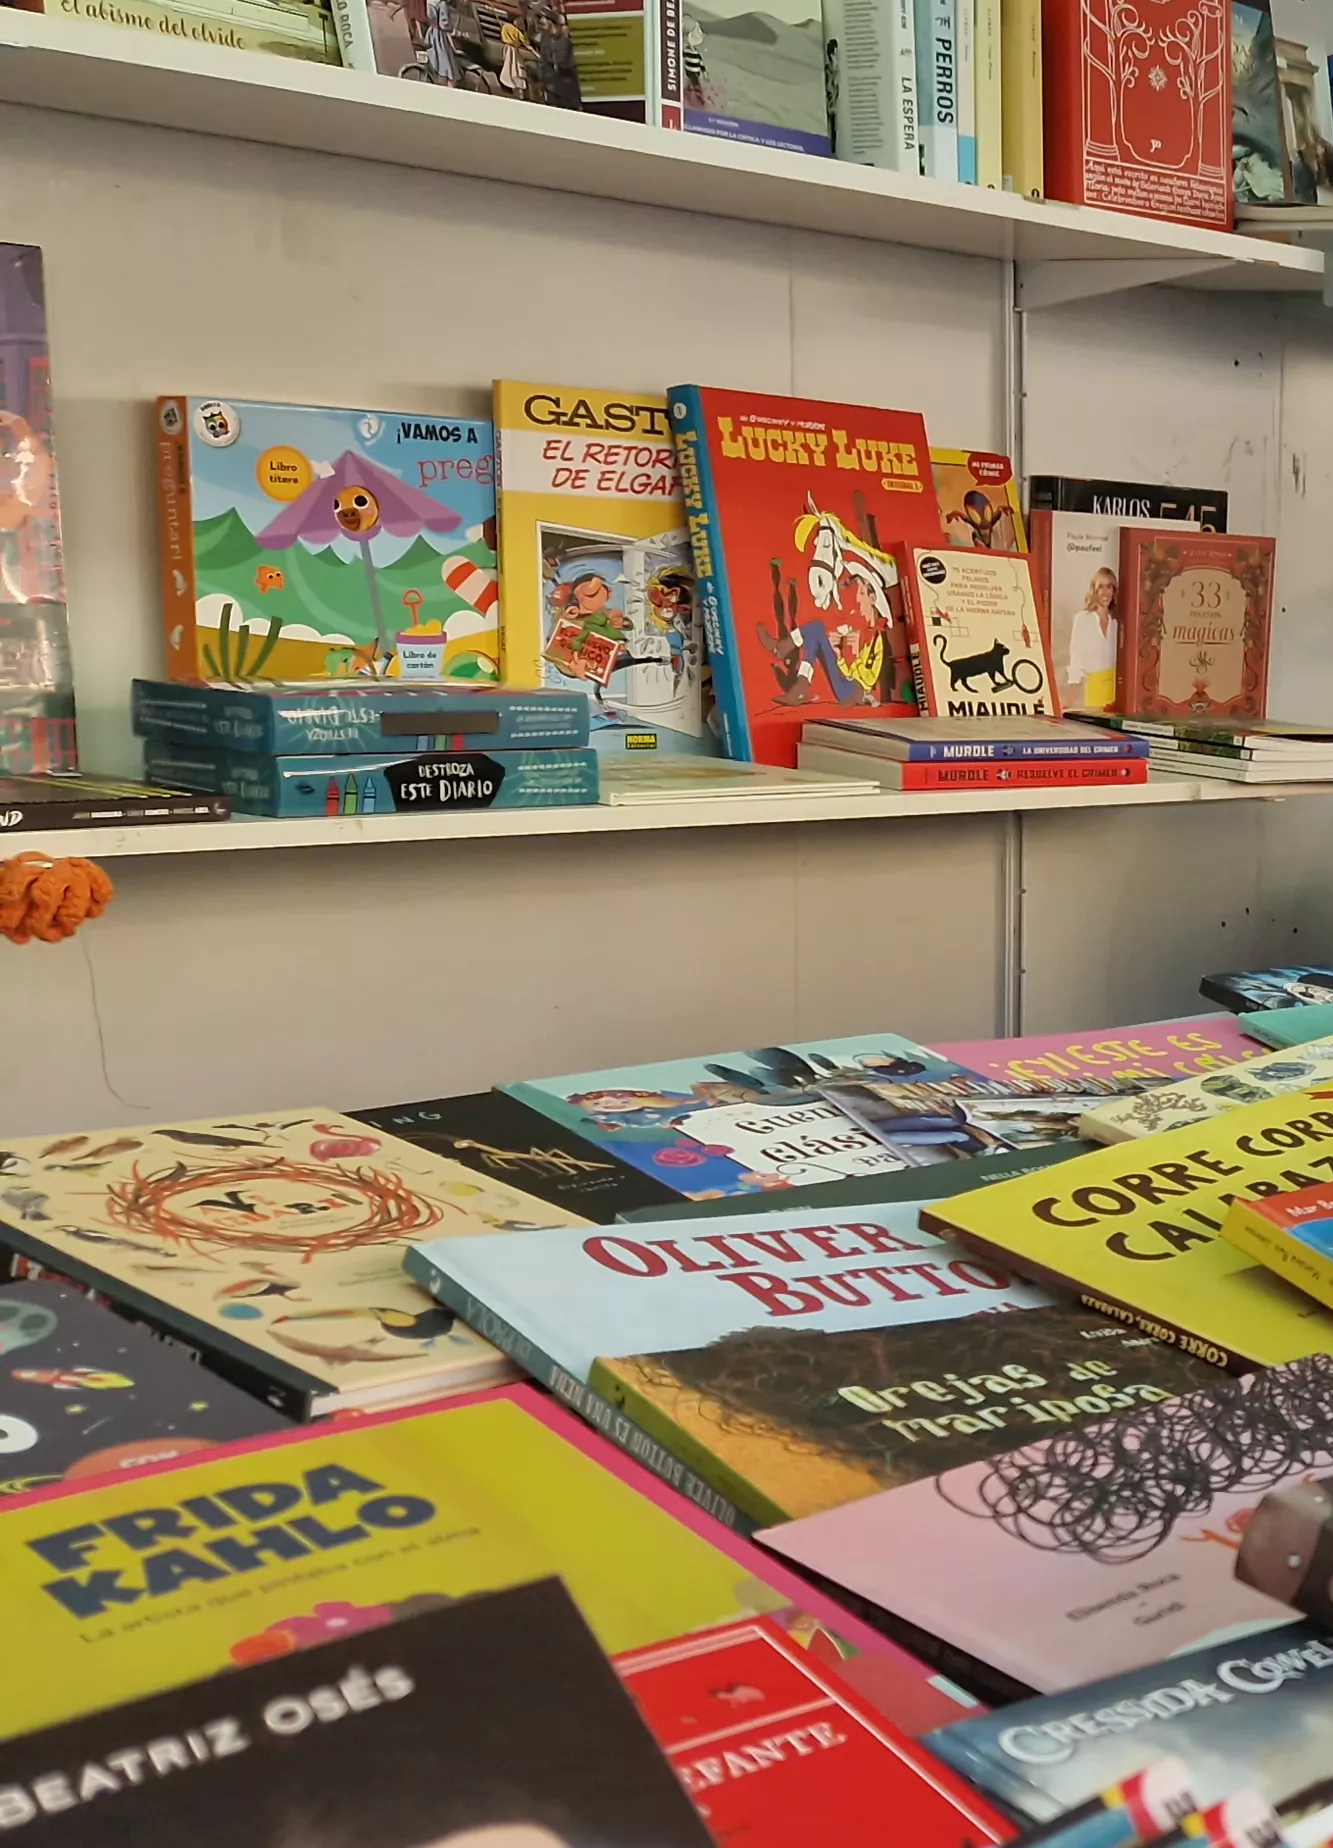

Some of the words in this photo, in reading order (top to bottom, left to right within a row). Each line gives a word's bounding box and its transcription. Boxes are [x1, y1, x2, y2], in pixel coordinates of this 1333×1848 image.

[86, 2, 153, 30] abismo
[159, 18, 188, 38] del
[191, 22, 245, 50] olvido
[340, 14, 355, 48] ROCA
[667, 22, 677, 38] DE
[667, 47, 678, 91] SIMONE
[901, 77, 912, 95] LA
[935, 37, 954, 125] PERROS
[902, 98, 917, 151] ESPERA
[523, 394, 671, 436] GAST
[396, 420, 461, 446] ¡VAMOS
[465, 425, 479, 444] A
[717, 416, 829, 468] LUCKY
[831, 428, 919, 477] LUKE
[269, 461, 298, 473] Libro
[543, 439, 575, 461] EL
[582, 442, 679, 471] RETOR
[551, 468, 590, 490] DE
[675, 431, 704, 511] LUCKY
[690, 511, 713, 577] LUKE
[1093, 495, 1151, 518] KARLOS
[1190, 580, 1223, 609] 33
[403, 651, 426, 660] Libro
[944, 744, 995, 758] MURDLE
[1022, 746, 1032, 755] LA
[1033, 745, 1079, 755] UNIVERSIDAD
[1080, 745, 1093, 754] DEL
[417, 763, 476, 779] DESTROZA
[938, 769, 989, 783] MURDLE
[1066, 768, 1078, 780] EL
[401, 782, 433, 801] ESTE
[439, 779, 494, 800] DIARIO
[1066, 1039, 1169, 1067] ESTE
[1167, 1032, 1223, 1052] ES
[734, 1104, 843, 1136] Cuen
[1031, 1149, 1244, 1229] CORRE
[1286, 1202, 1316, 1217] Mar
[583, 1222, 922, 1278] OLIVER
[717, 1259, 1011, 1318] BUTTO
[1186, 1336, 1228, 1369] CORRE
[838, 1362, 1050, 1415] Orejas
[1069, 1358, 1118, 1385] de
[880, 1382, 1173, 1444] mariposa
[614, 1417, 630, 1448] ES
[631, 1435, 686, 1492] BUTTON
[684, 1473, 737, 1526] OLIVER
[25, 1463, 388, 1573] FRIDA
[41, 1494, 437, 1621] KAHLO
[80, 1628, 116, 1645] La
[263, 1663, 415, 1736] OSÉS
[998, 1677, 1235, 1767] CRESSIDA
